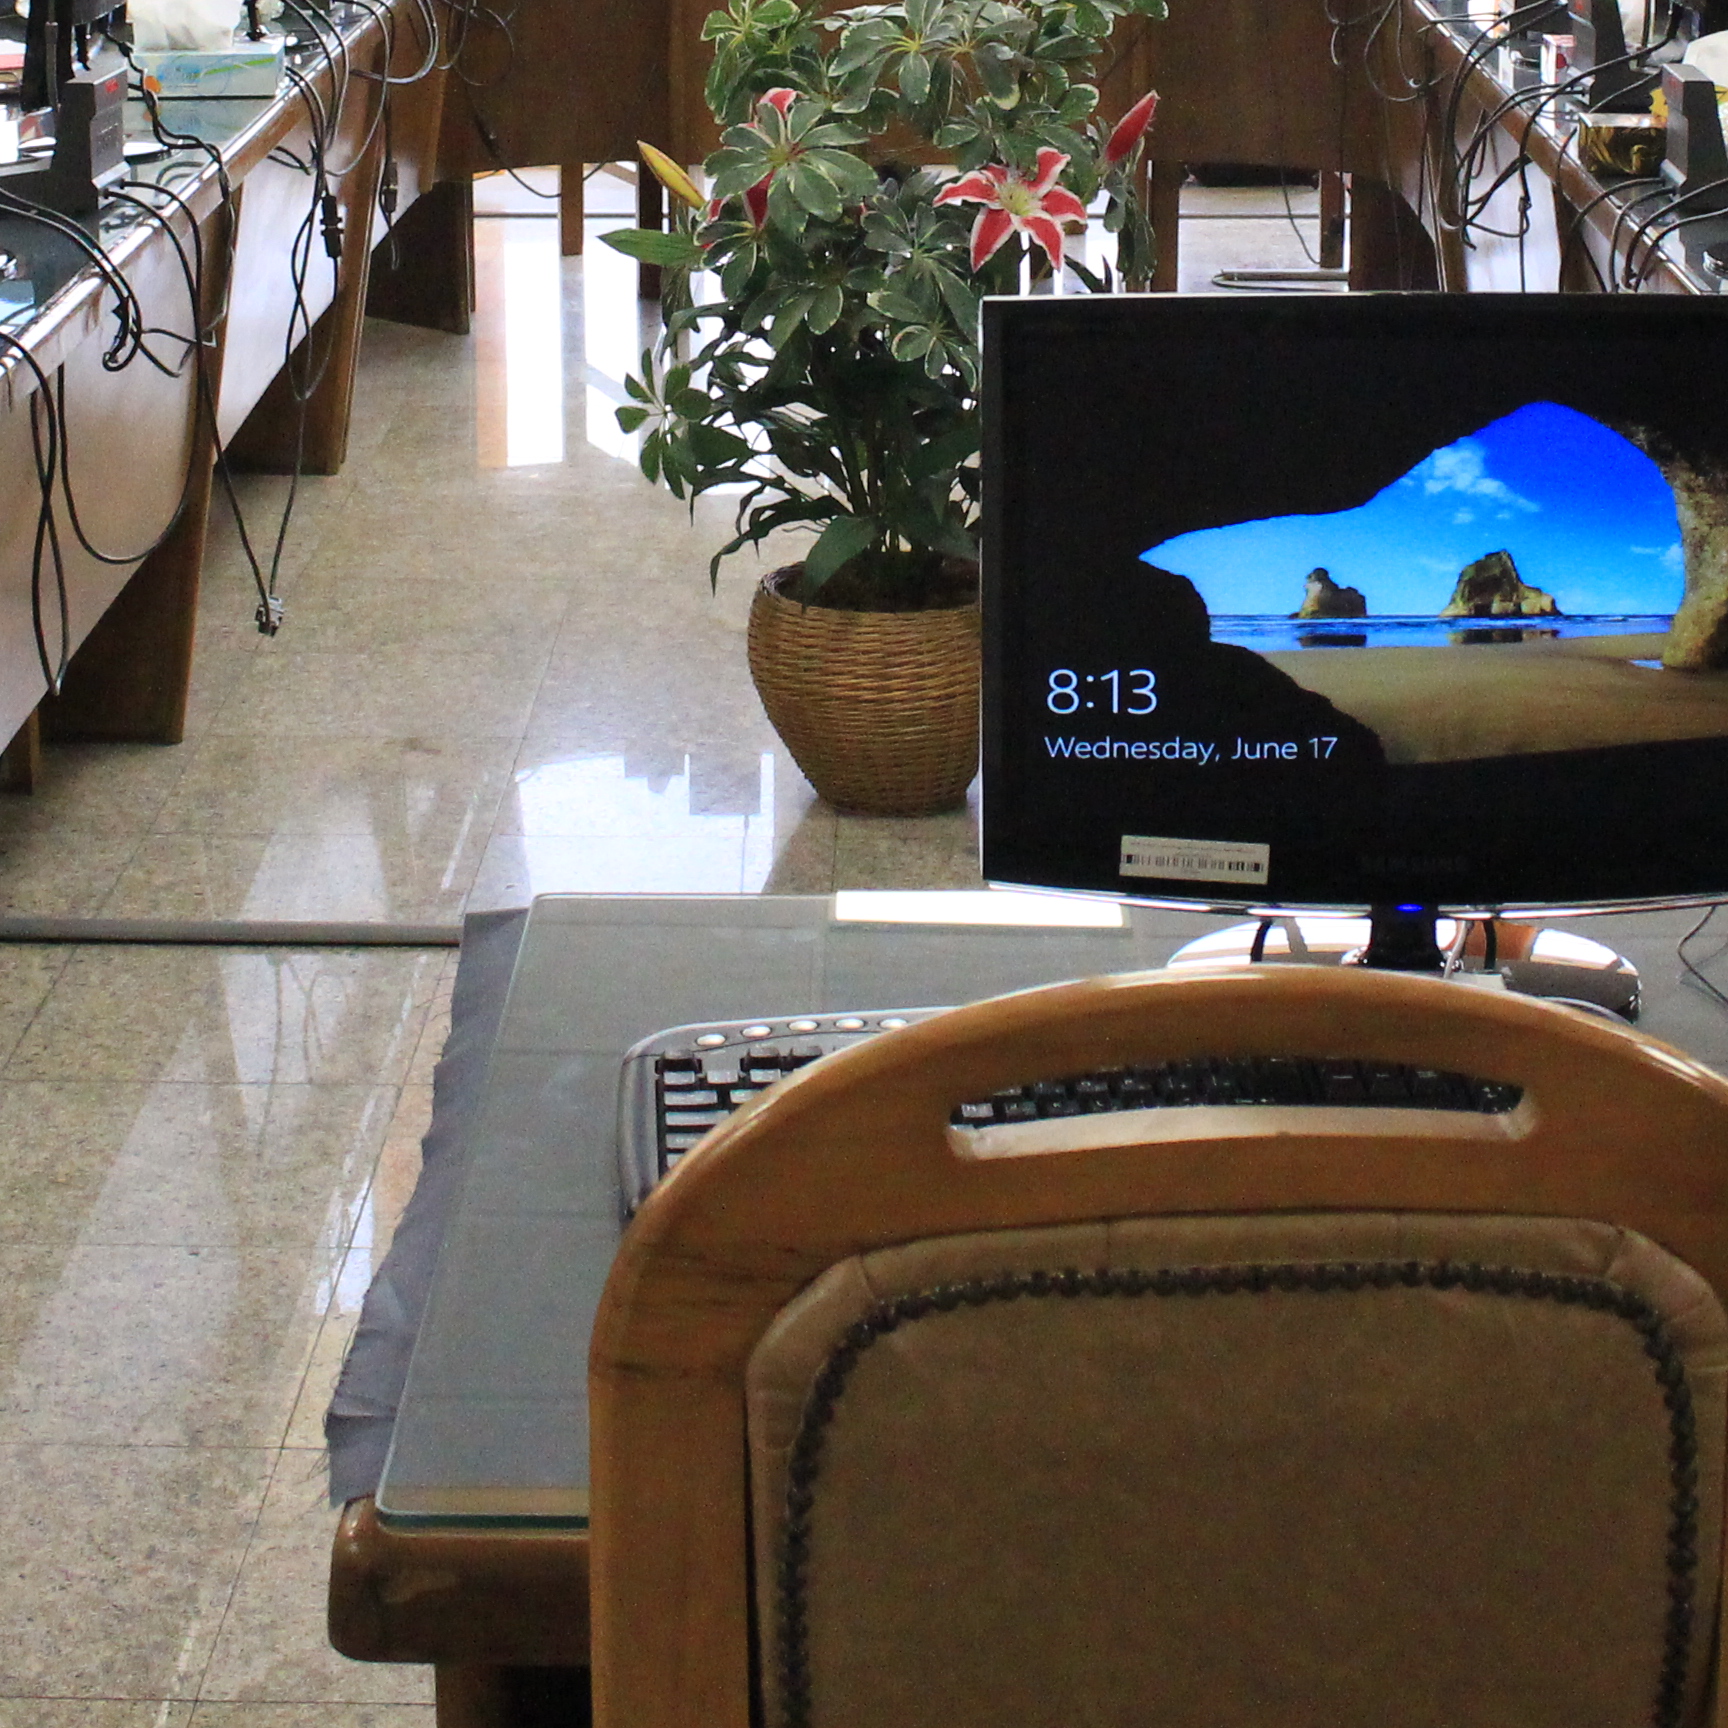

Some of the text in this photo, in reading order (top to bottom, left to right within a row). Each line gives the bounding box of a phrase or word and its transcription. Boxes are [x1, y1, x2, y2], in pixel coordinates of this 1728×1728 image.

[1047, 669, 1157, 714] 8:13
[1044, 736, 1338, 766] Wednesday, June 17
